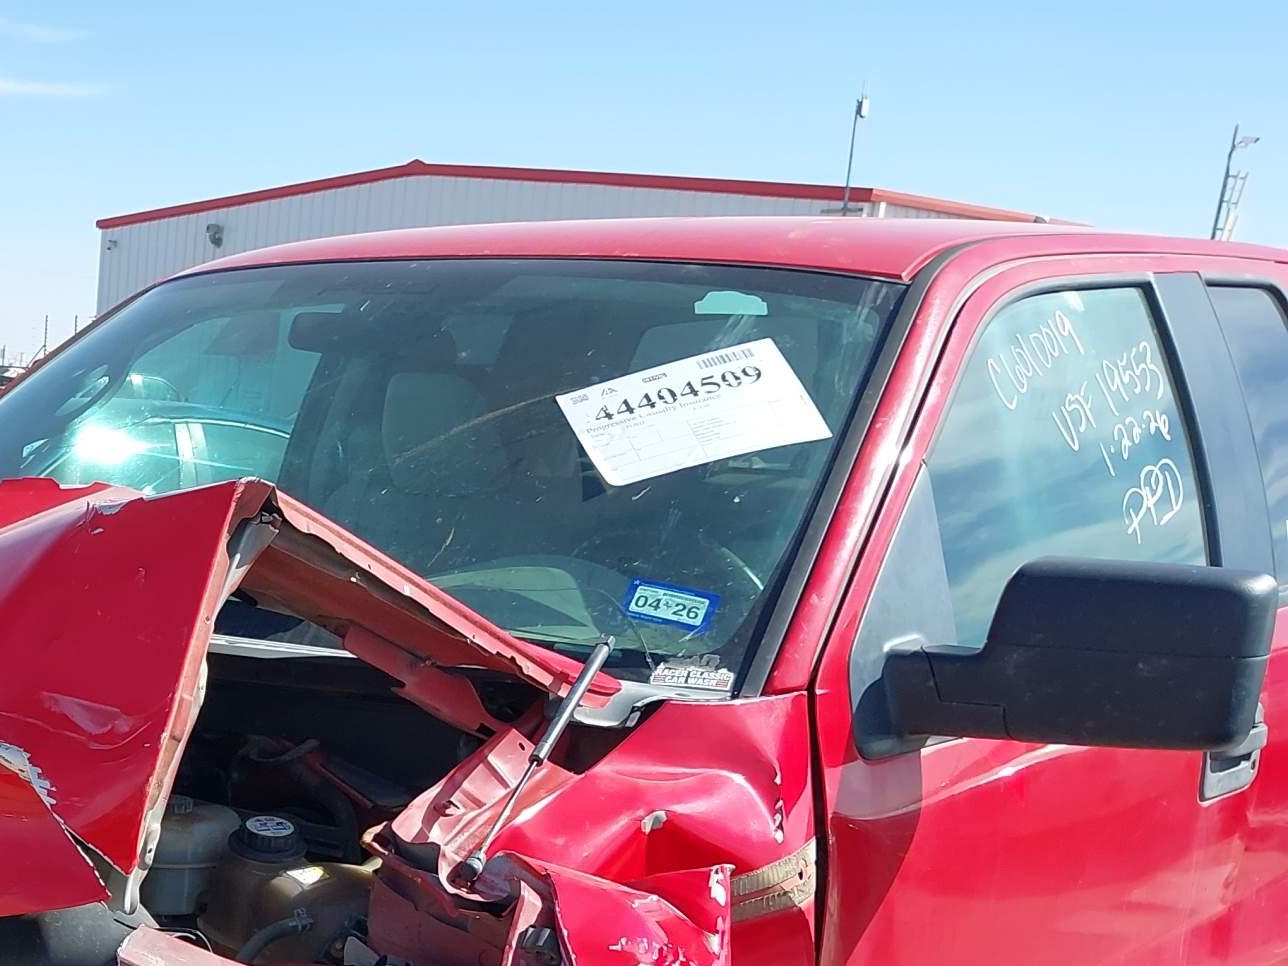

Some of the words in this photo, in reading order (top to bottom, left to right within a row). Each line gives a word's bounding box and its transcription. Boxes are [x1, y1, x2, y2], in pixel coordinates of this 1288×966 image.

[594, 364, 763, 422] 44404509
[634, 594, 661, 612] 04
[671, 602, 701, 620] 26
[664, 676, 687, 684] CAR
[689, 669, 732, 681] CLASSIC
